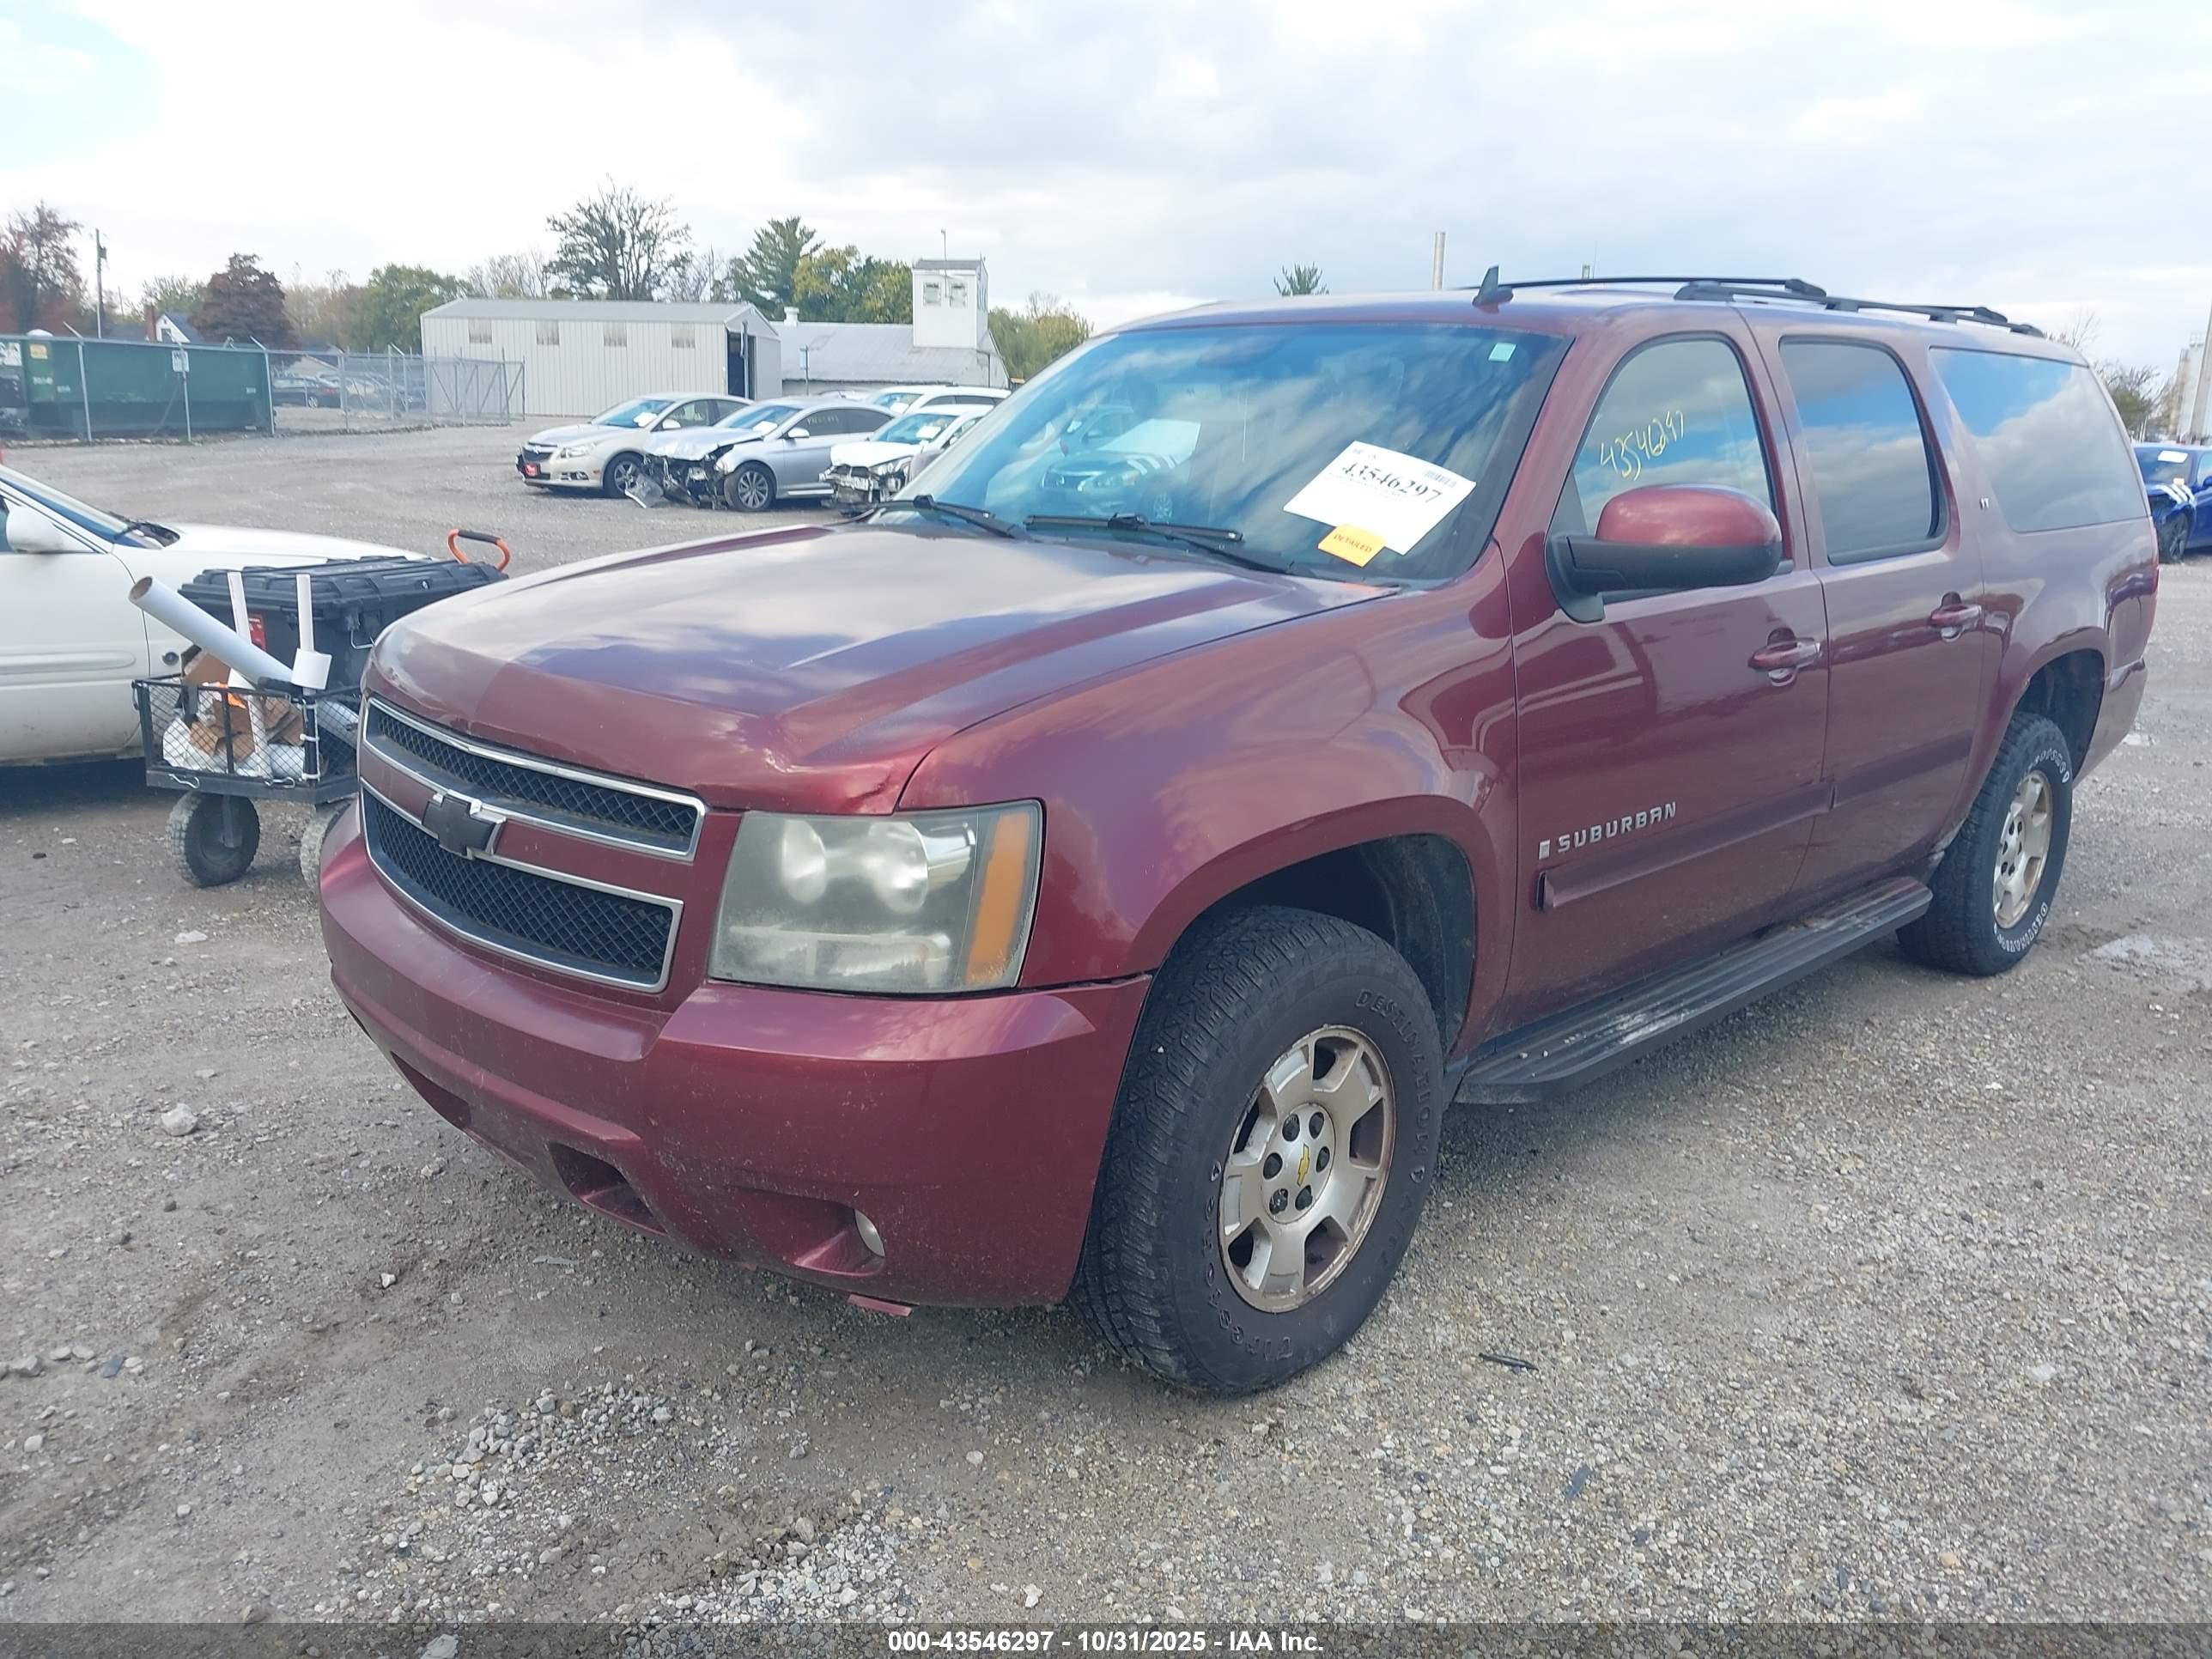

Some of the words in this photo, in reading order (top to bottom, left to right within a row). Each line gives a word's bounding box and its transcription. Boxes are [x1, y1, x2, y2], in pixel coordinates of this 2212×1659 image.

[1600, 410, 1685, 482] 43546297
[1341, 462, 1443, 504] 43546297
[1332, 532, 1374, 553] DETAILED
[1557, 800, 1677, 854] SUBURBAN
[1353, 988, 1433, 1156] DESTINATION
